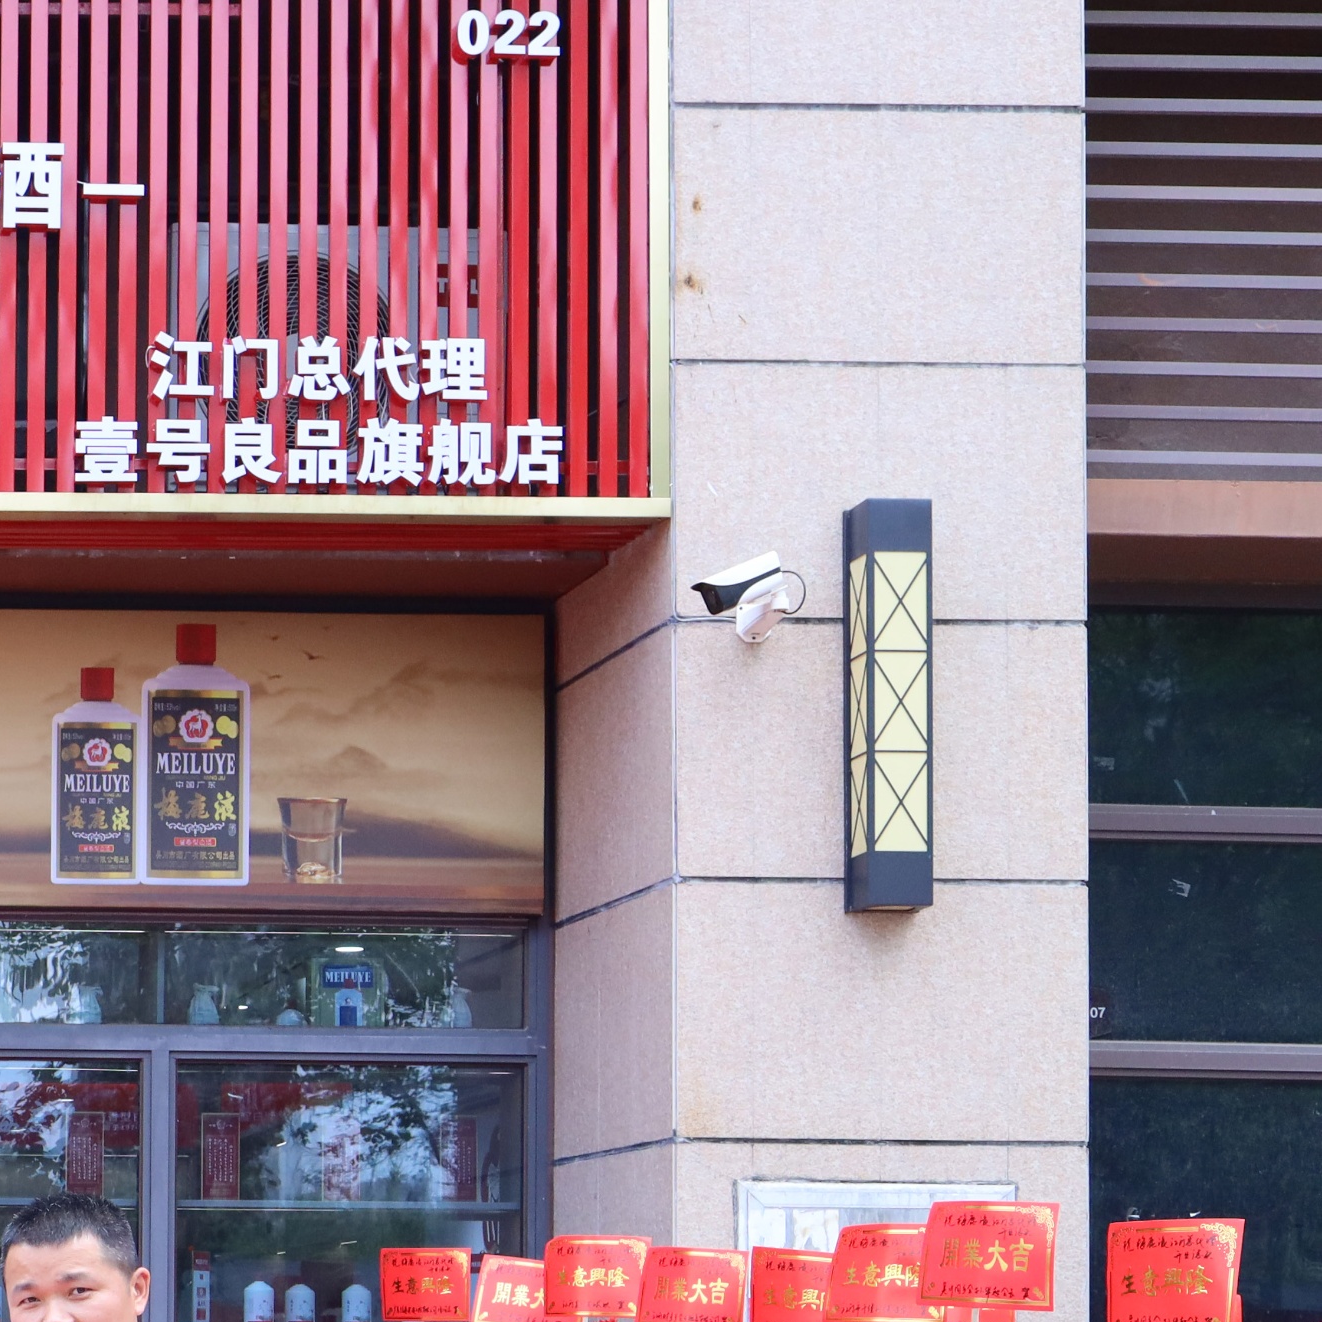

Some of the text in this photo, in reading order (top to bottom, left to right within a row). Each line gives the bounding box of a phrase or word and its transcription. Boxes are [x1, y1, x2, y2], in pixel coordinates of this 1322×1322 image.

[456, 9, 561, 60] 022
[148, 331, 489, 402] 江门总代理
[74, 415, 564, 486] 壹号良品旗舰店
[156, 752, 237, 775] MEILUYE
[63, 774, 131, 793] MEILUYE
[175, 780, 217, 789] 中国广东
[939, 1237, 1035, 1273] 開業大吉
[392, 1275, 456, 1297] 生意興隆
[557, 1265, 631, 1288] 生意興隆
[653, 1276, 730, 1306] 開業大吉
[1120, 1264, 1214, 1297] 生意興隆
